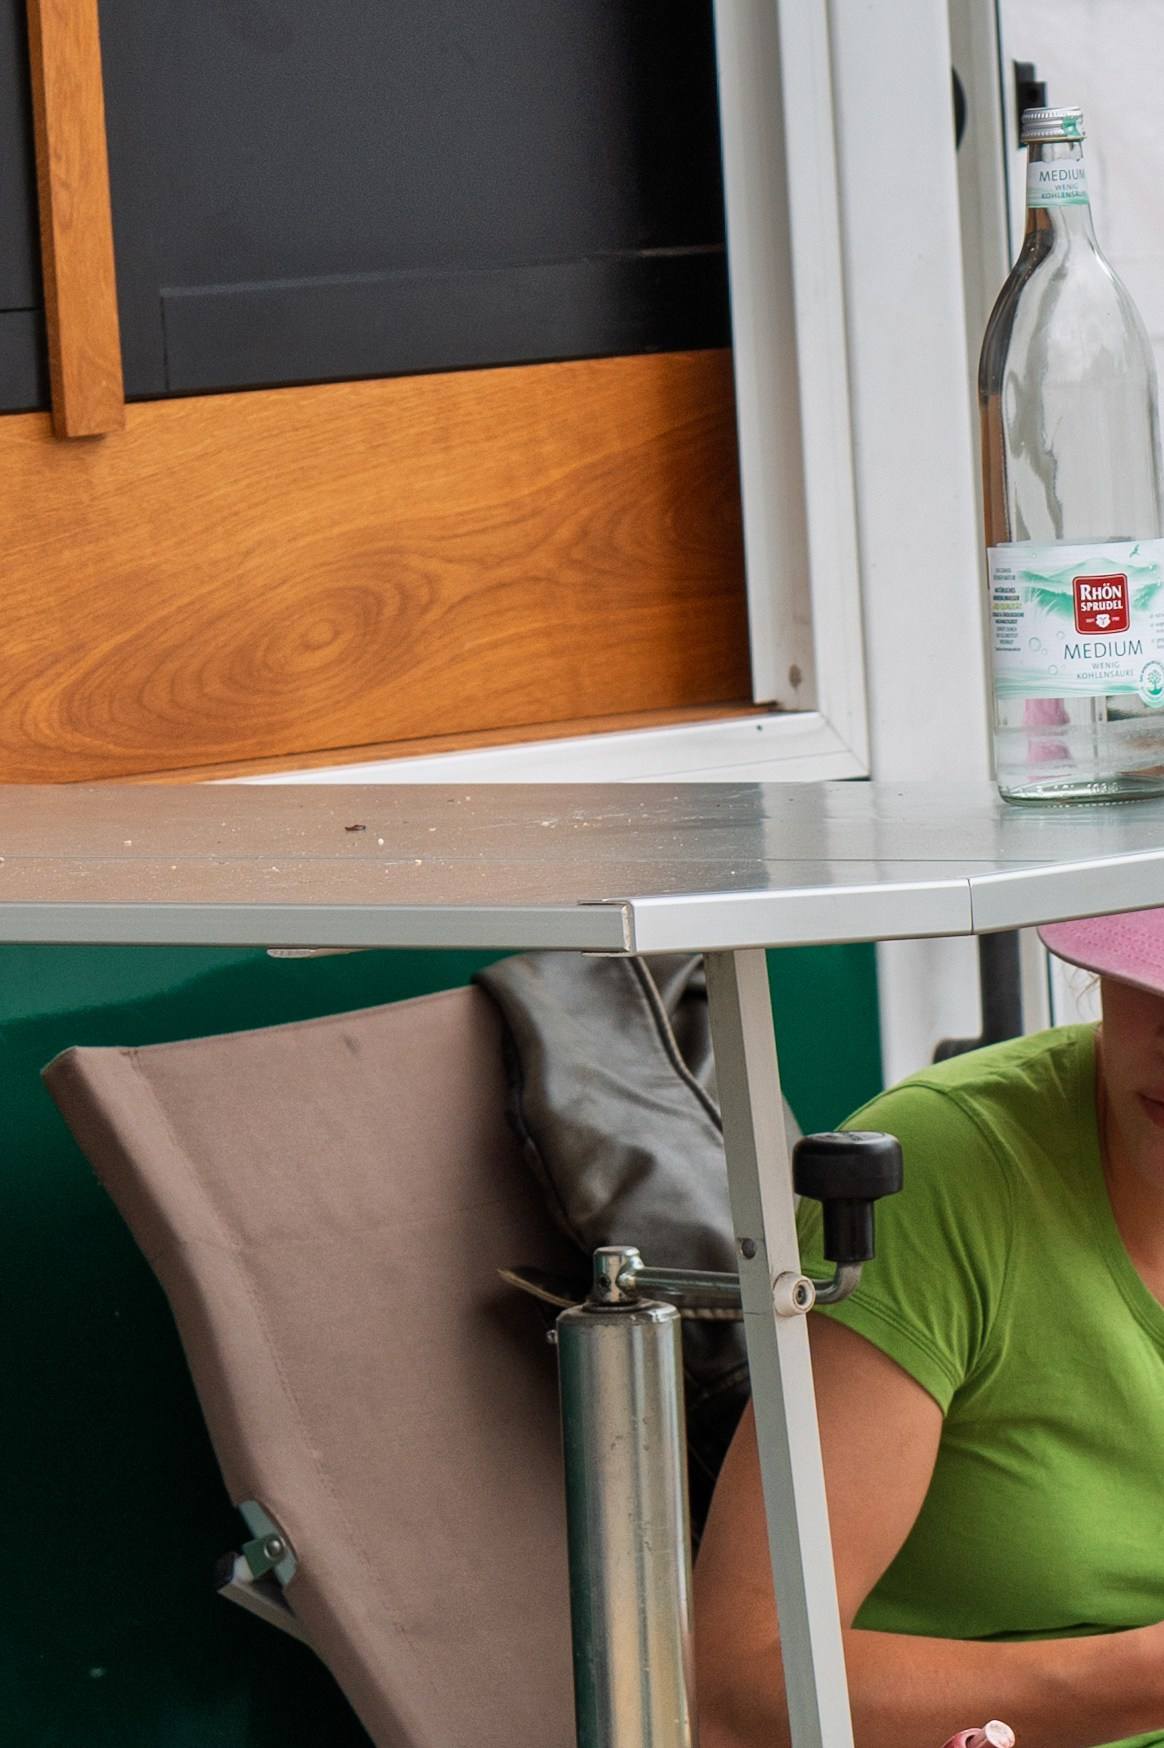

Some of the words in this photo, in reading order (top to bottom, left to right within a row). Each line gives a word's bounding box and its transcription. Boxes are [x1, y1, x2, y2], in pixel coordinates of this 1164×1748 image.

[1080, 583, 1122, 600] RHÖN
[1081, 600, 1123, 611] SPRUDEL
[1064, 640, 1142, 660] MEDIUM
[1092, 661, 1120, 669] WENIG
